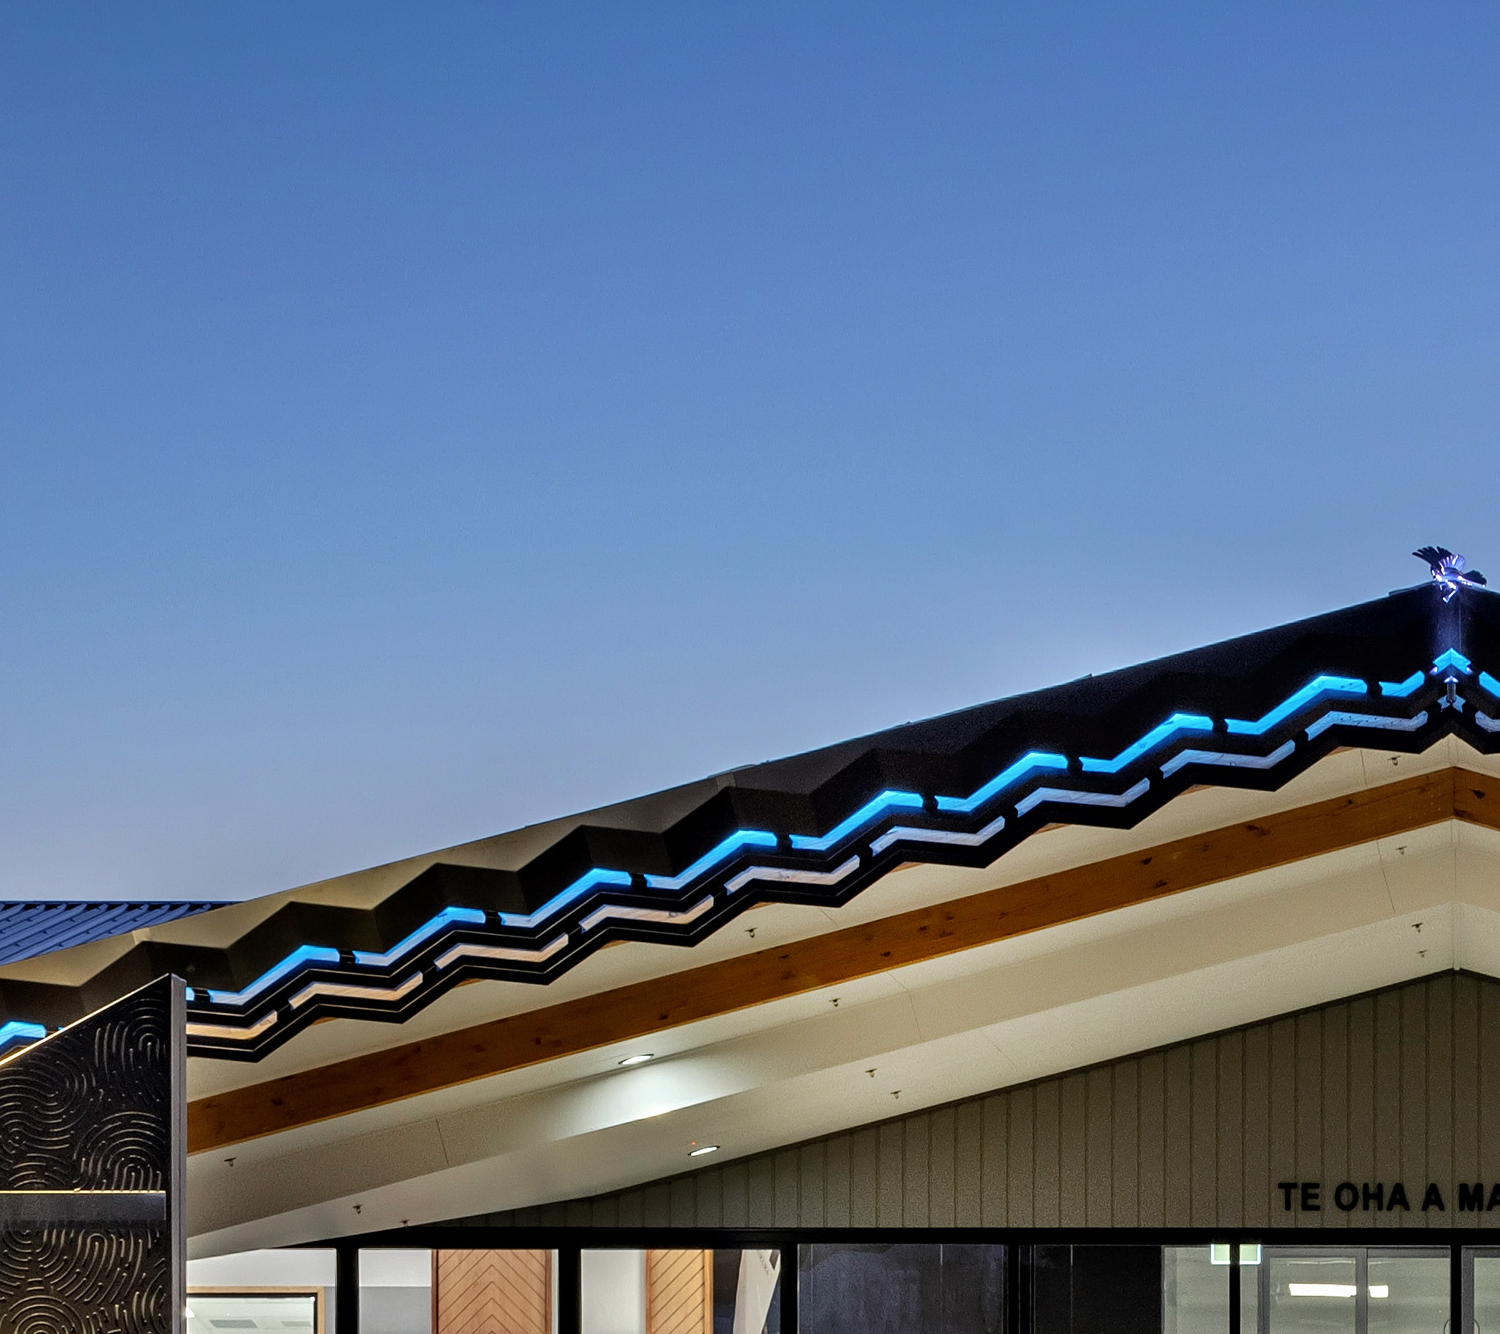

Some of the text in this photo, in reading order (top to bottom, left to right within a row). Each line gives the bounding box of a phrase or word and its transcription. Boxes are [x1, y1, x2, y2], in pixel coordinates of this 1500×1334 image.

[1278, 1183, 1320, 1211] TE
[1334, 1182, 1410, 1211] OHA
[1421, 1183, 1445, 1211] A
